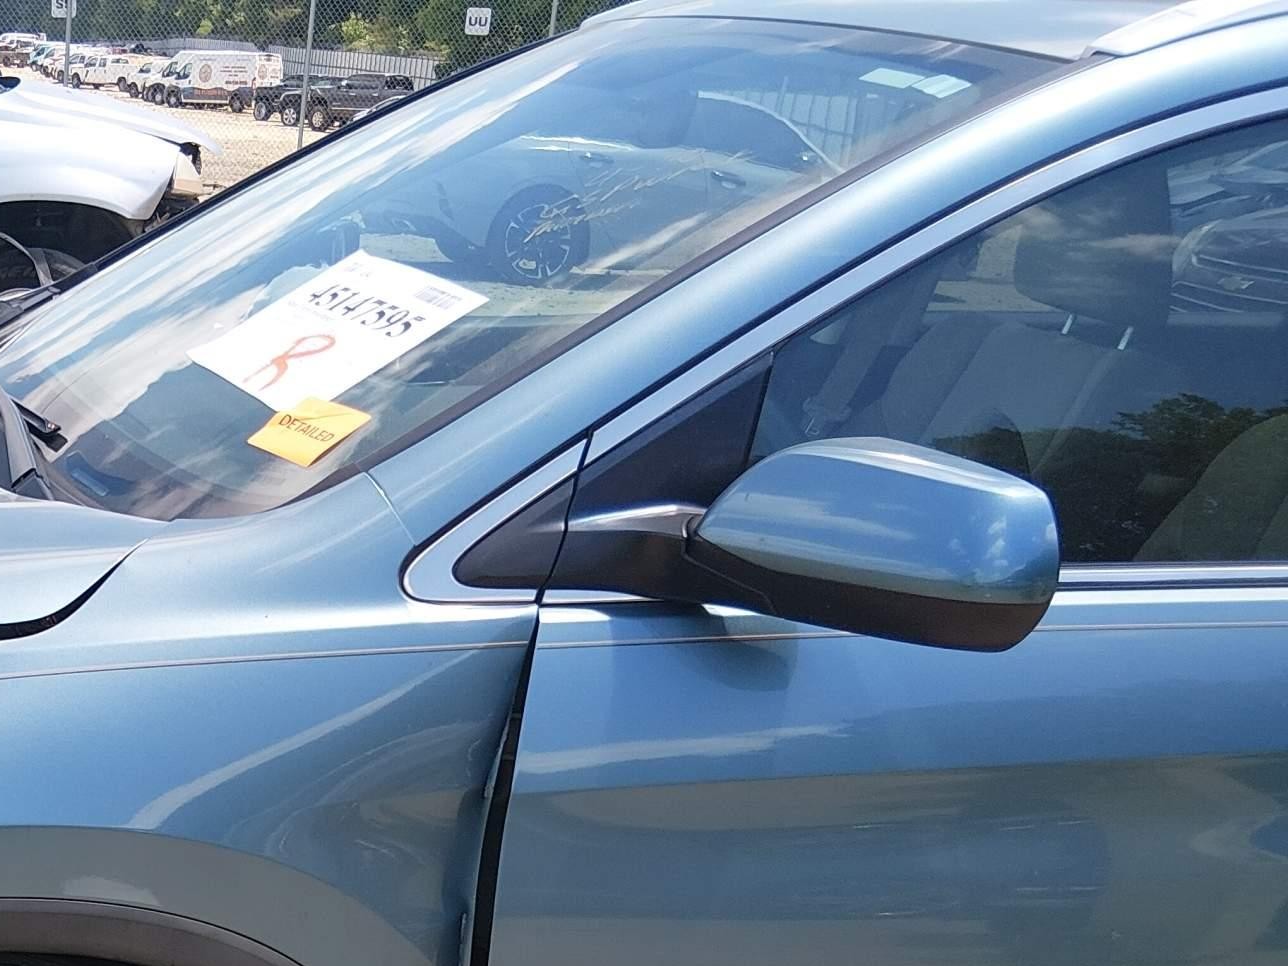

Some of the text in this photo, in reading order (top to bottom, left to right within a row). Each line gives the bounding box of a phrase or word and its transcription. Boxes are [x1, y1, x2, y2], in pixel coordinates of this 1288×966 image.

[468, 16, 489, 27] UU
[309, 284, 427, 338] 45147595
[278, 414, 335, 442] DETAILED
